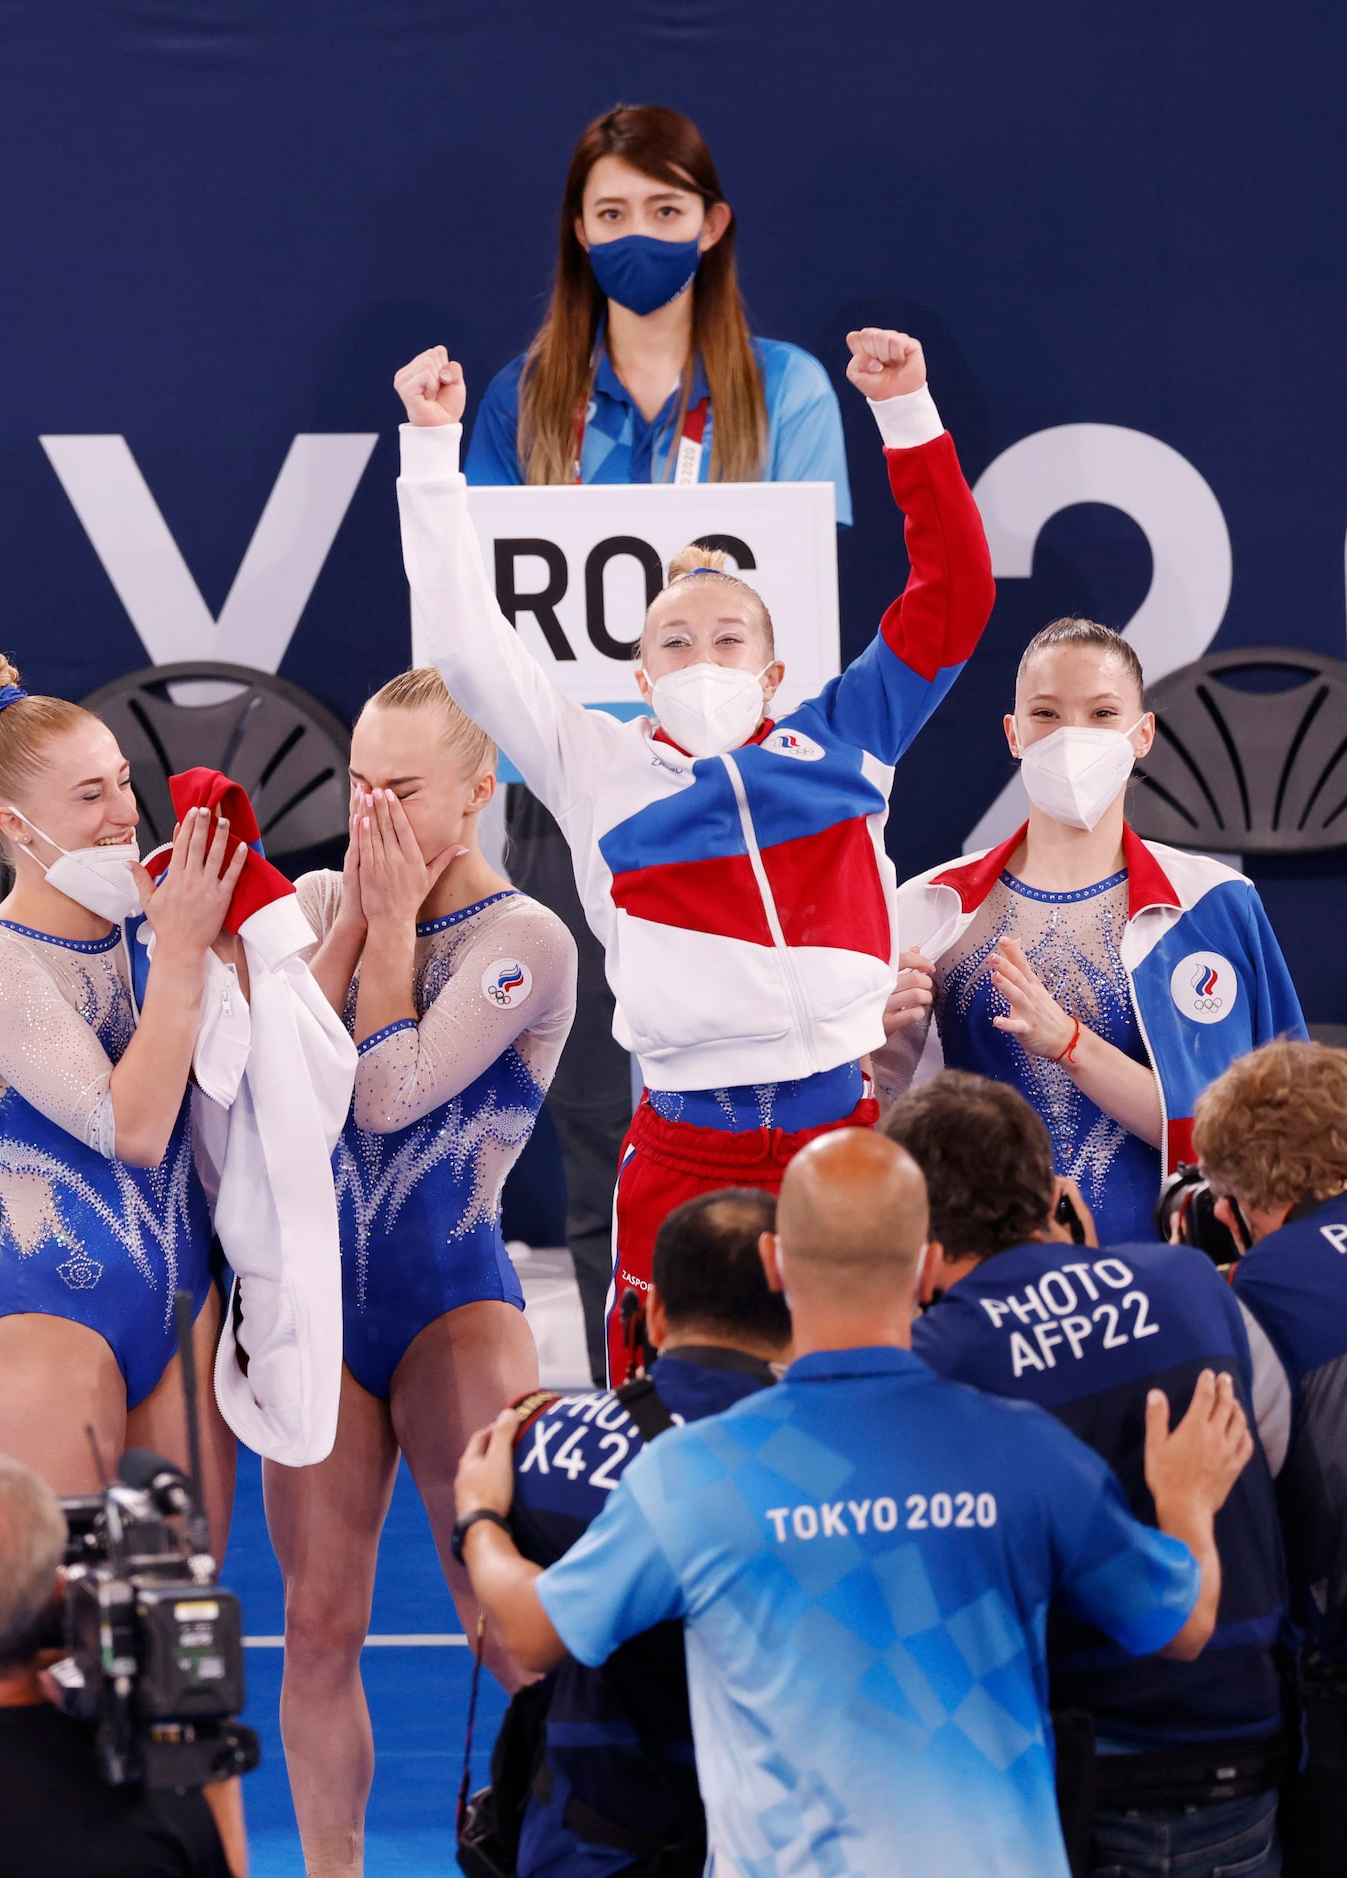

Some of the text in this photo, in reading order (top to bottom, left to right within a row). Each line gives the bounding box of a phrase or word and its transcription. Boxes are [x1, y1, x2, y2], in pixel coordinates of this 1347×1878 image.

[979, 1258, 1134, 1329] PHOTO
[1009, 1290, 1160, 1378] AFP22
[519, 1420, 649, 1490] X42
[765, 1491, 997, 1543] TOKYO 2020
